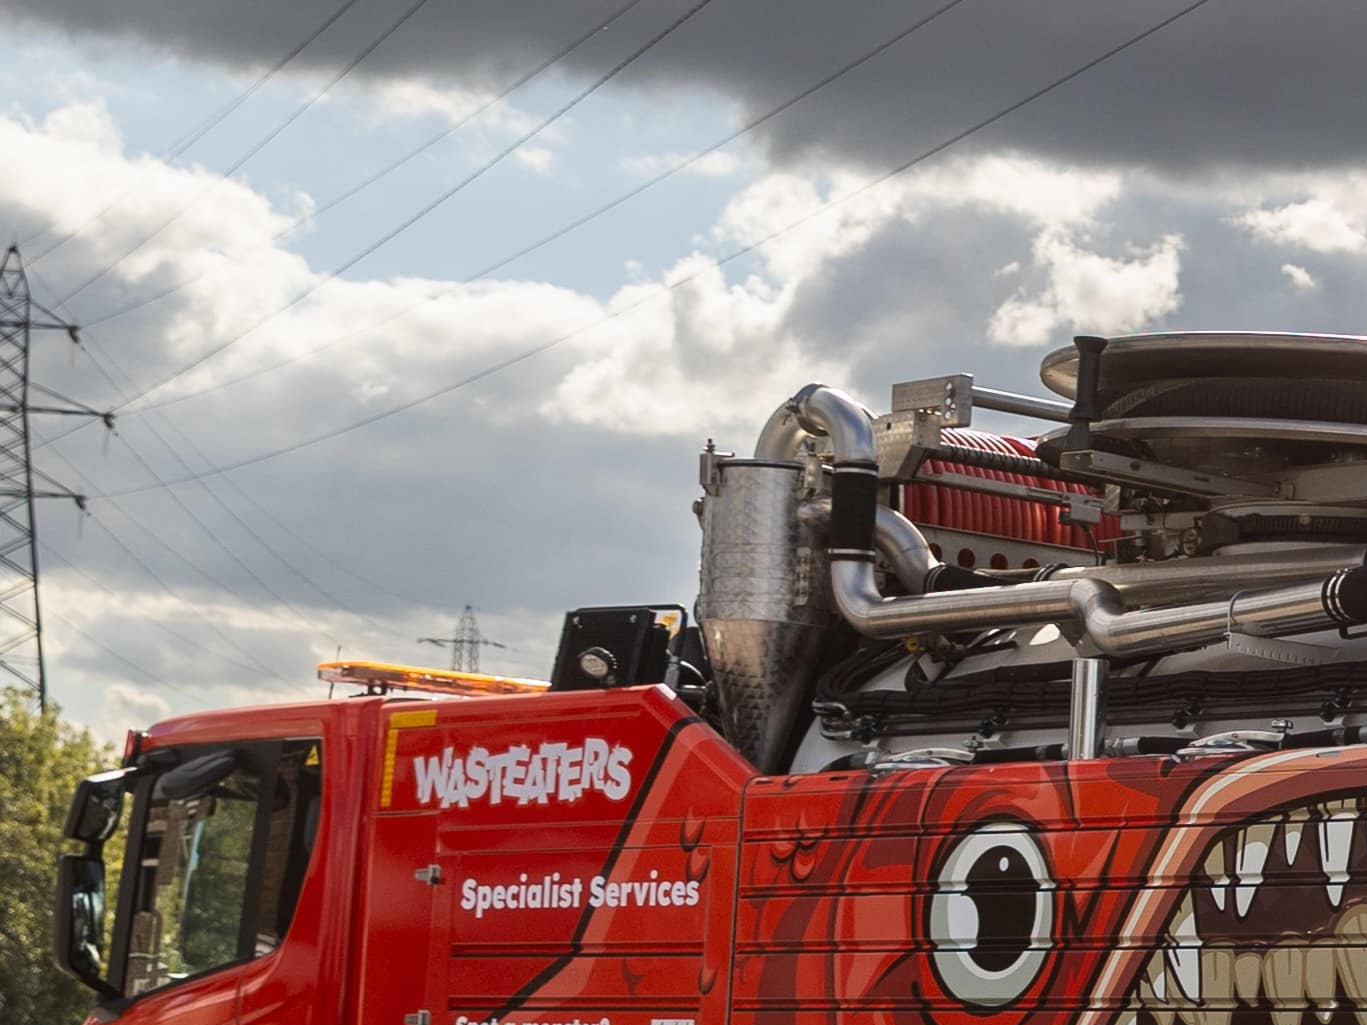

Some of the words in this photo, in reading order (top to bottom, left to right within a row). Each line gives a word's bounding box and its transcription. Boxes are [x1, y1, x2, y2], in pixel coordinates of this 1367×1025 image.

[414, 738, 632, 808] WASTEATERS
[461, 873, 582, 918] Specialist
[589, 870, 699, 908] Services
